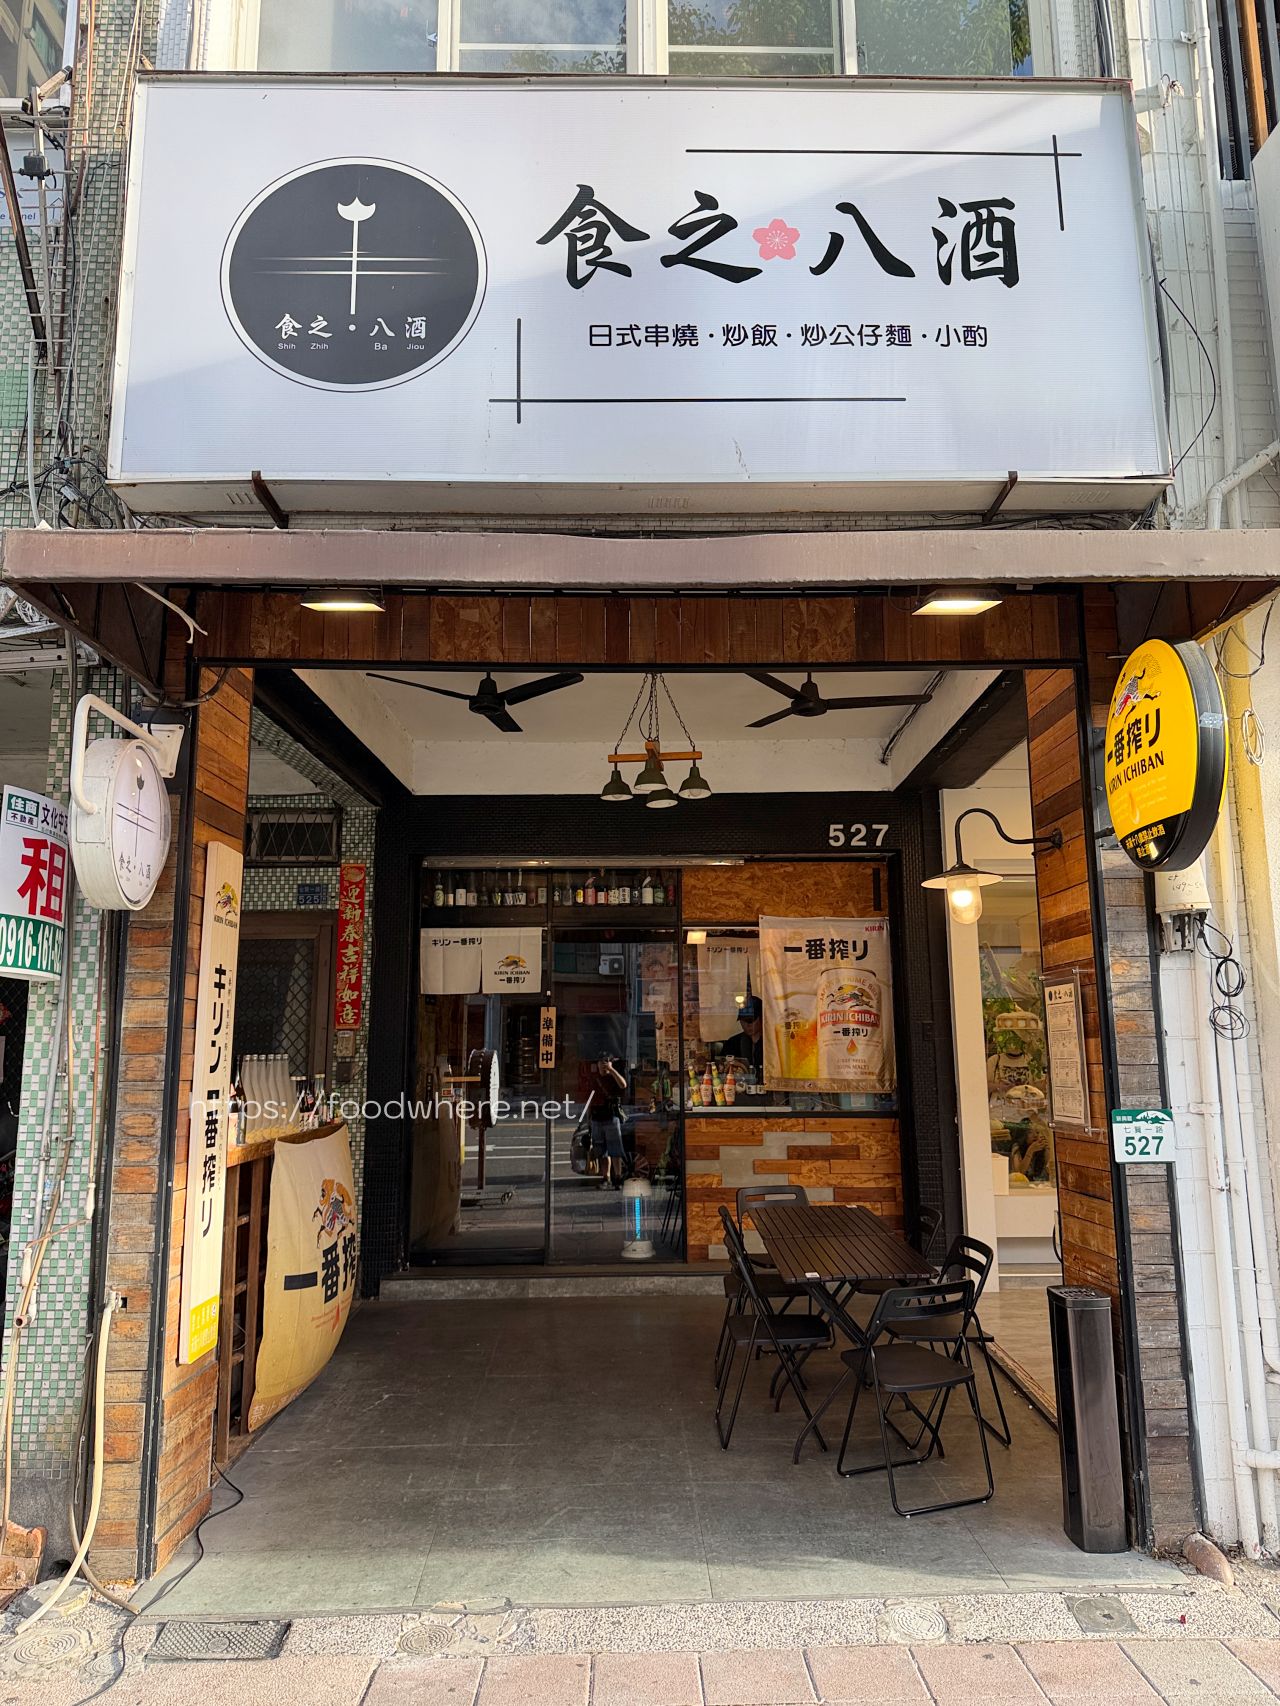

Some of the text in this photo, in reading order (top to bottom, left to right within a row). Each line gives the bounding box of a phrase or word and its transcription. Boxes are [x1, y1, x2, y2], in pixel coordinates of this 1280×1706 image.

[1107, 708, 1161, 767] 一番搾り
[1124, 751, 1165, 782] ICHIBAN
[11, 796, 38, 816] 住商
[828, 823, 889, 847] 527
[17, 837, 67, 922] 租
[299, 895, 320, 904] 525
[864, 925, 884, 933] KIRIN
[432, 937, 482, 948] キリン一番搾り
[784, 938, 869, 961] 一番搾り
[339, 885, 362, 1024] 迎新春吉祥如意
[499, 976, 525, 984] 一番搾り
[821, 1012, 881, 1025] KIRIN ICHIBAN
[541, 1016, 554, 1065] 準備中
[833, 1027, 868, 1038] 一番搾り
[1124, 1135, 1164, 1156] 527
